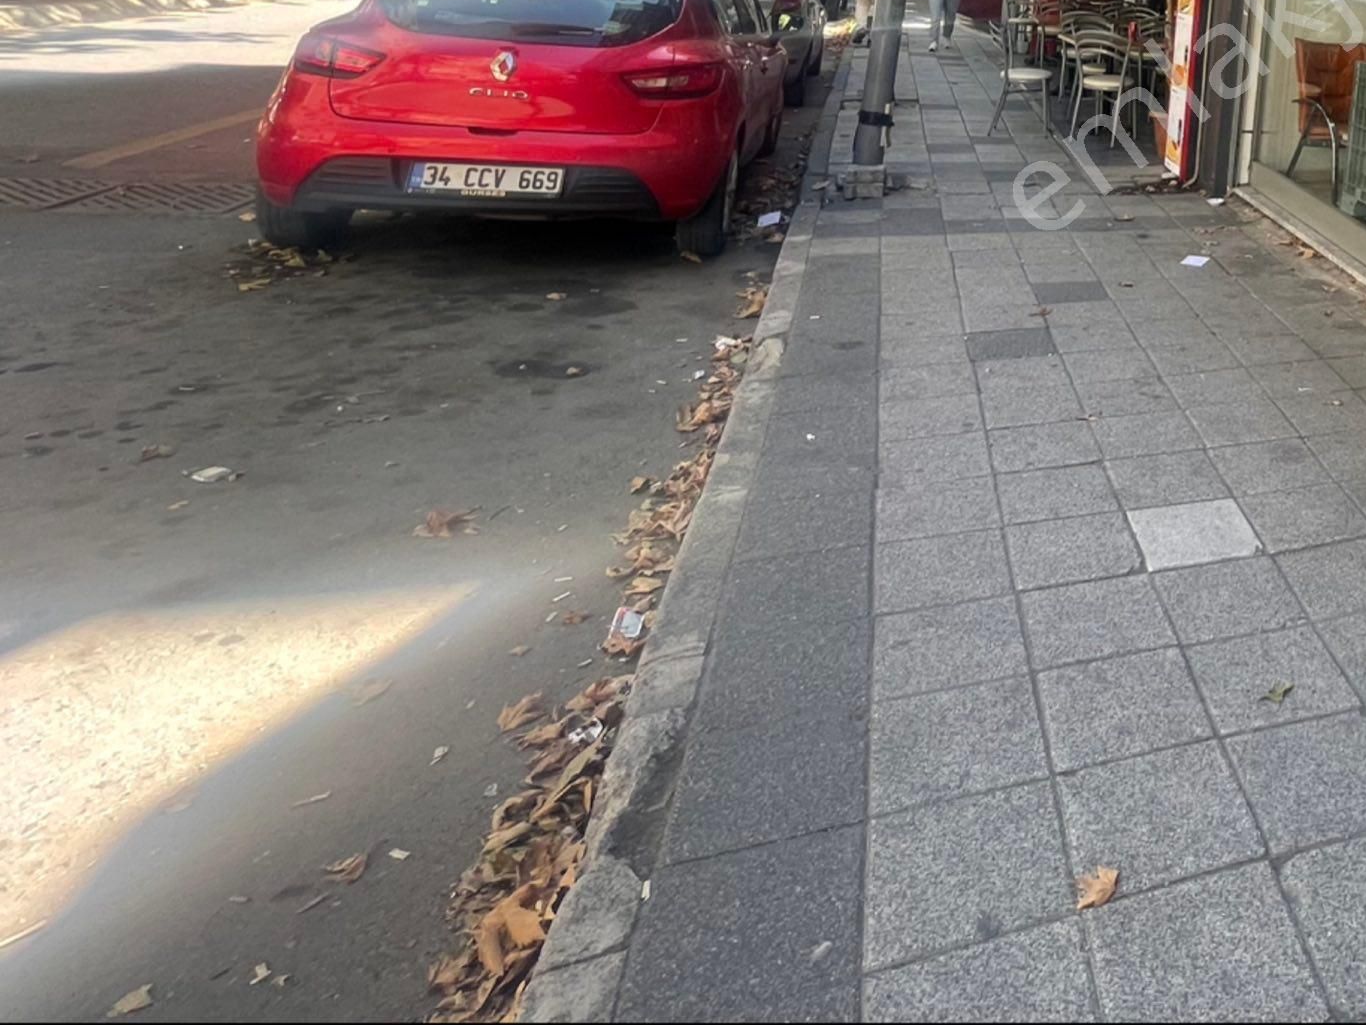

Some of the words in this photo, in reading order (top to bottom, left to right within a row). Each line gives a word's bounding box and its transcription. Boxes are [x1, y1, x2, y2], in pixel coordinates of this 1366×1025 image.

[423, 166, 450, 186] 34
[463, 167, 506, 188] CCV
[518, 169, 560, 190] 669
